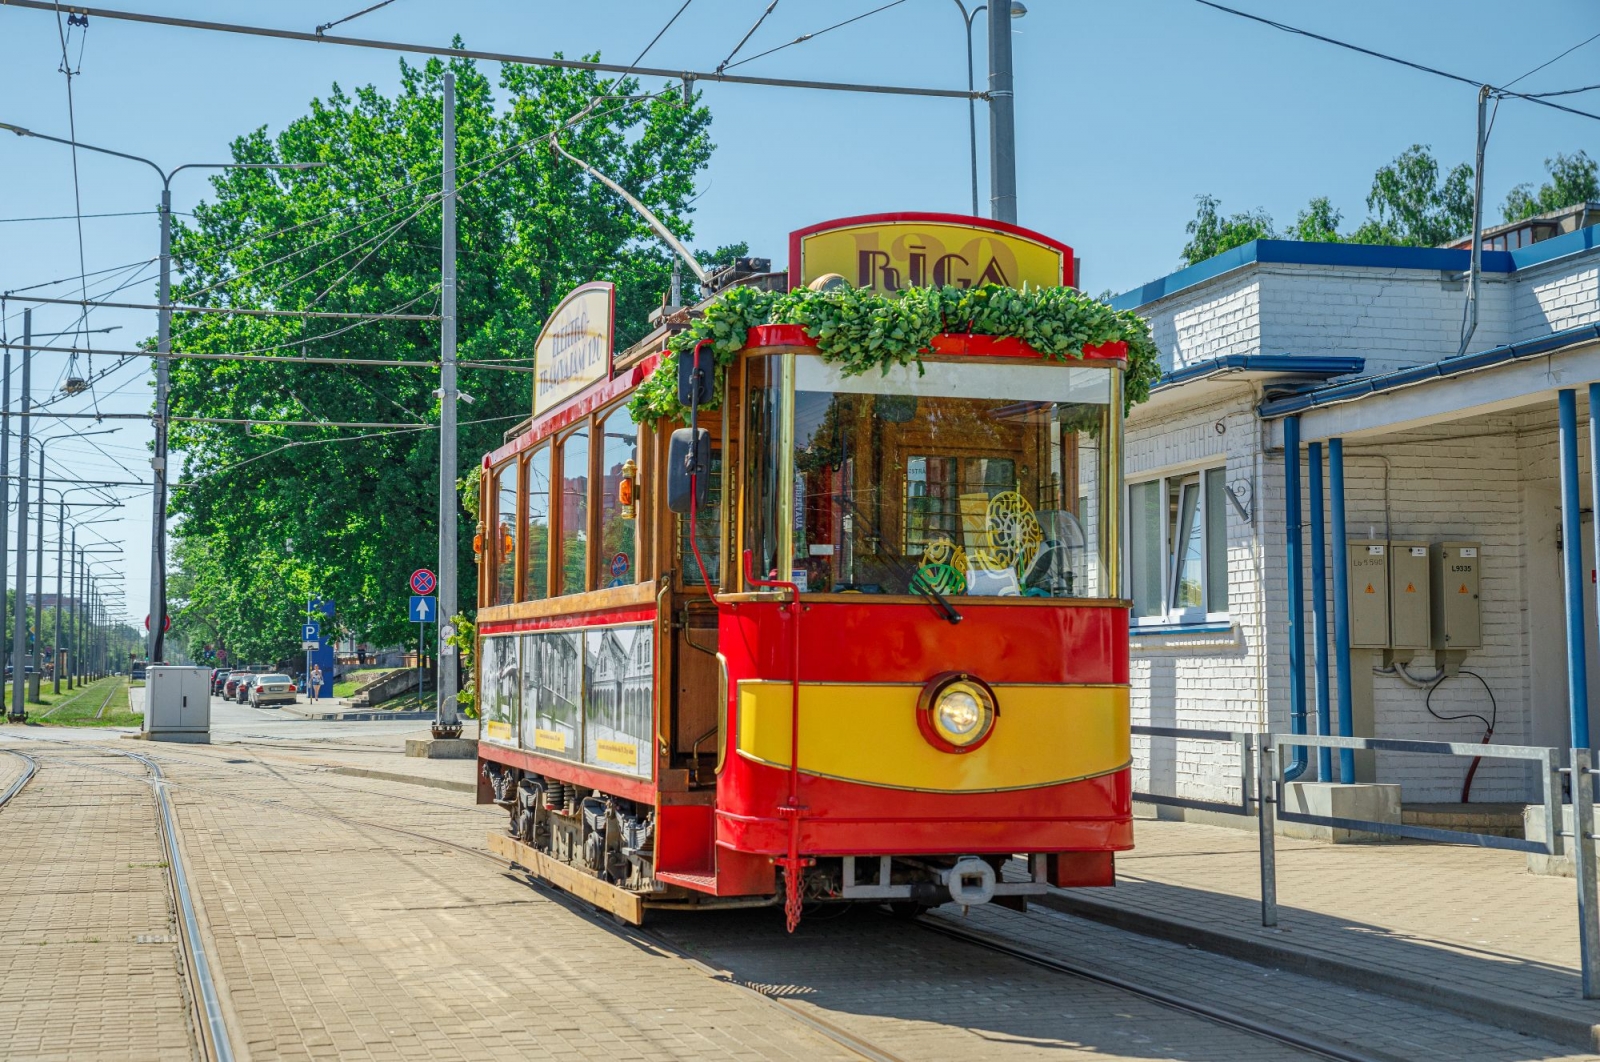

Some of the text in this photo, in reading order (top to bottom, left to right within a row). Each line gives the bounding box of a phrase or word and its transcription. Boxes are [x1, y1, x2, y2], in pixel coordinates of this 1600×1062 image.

[858, 245, 1010, 291] RĪGA
[588, 333, 604, 366] 120
[305, 626, 315, 639] P
